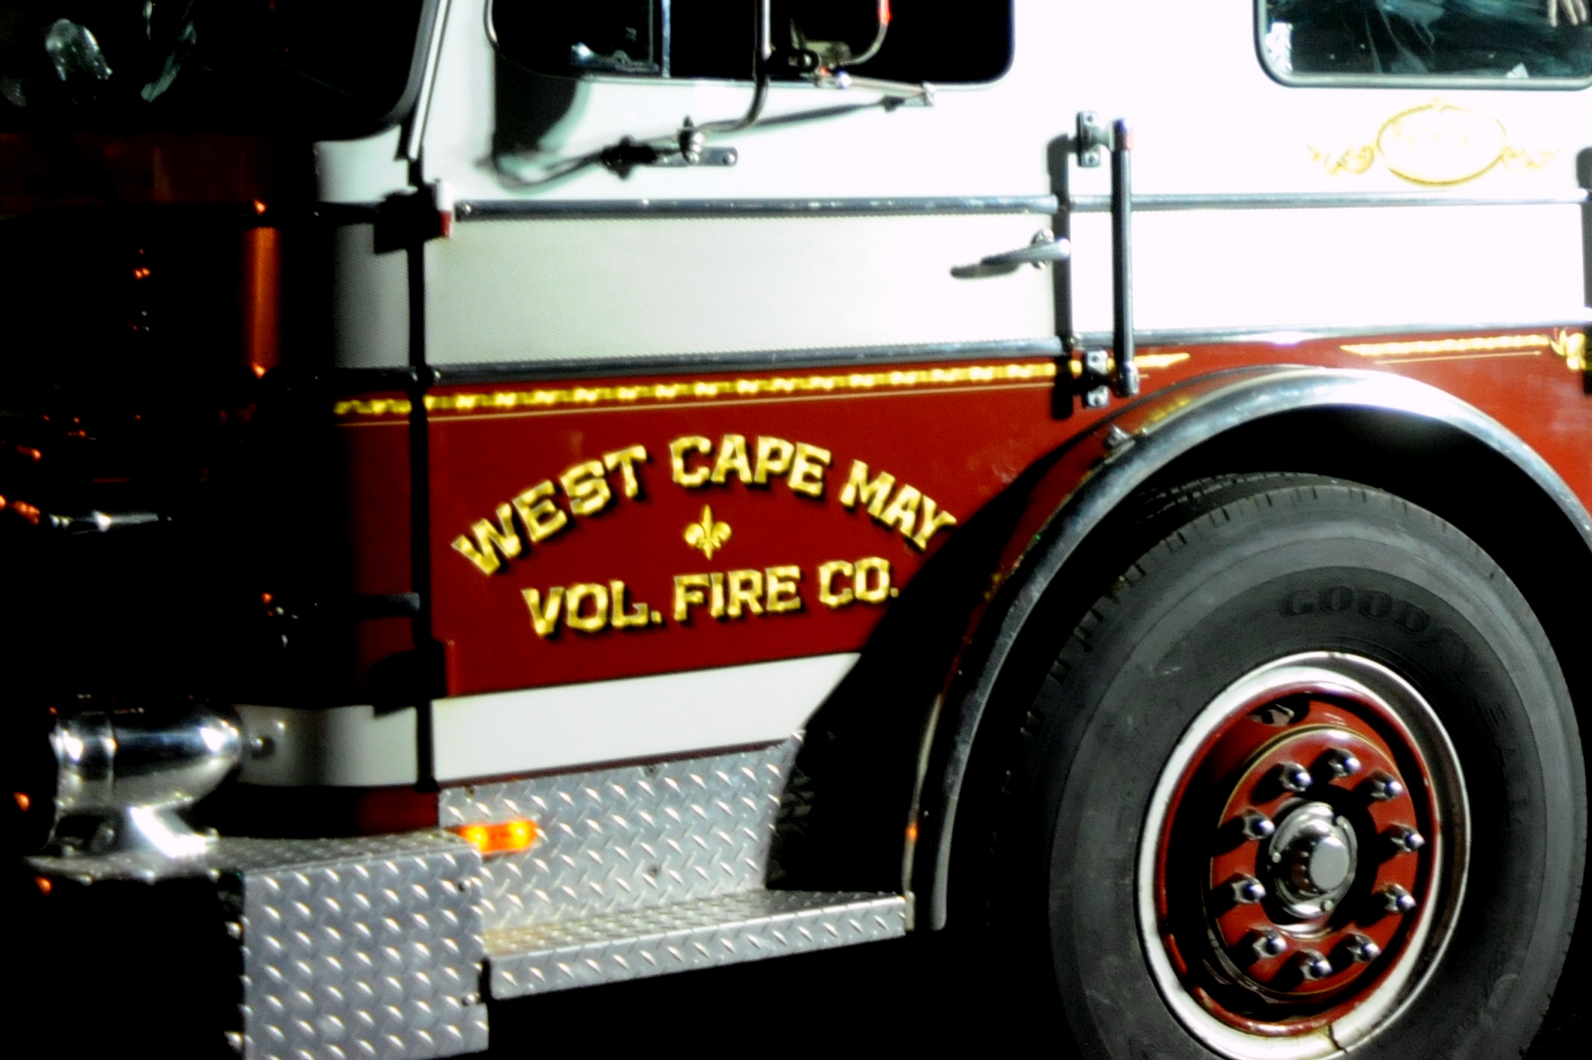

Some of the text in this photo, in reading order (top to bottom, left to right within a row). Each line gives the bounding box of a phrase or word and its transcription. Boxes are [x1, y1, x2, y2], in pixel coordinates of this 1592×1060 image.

[451, 434, 957, 576] WEST CAPE MAY
[521, 556, 899, 638] VOL. FIRE CO.
